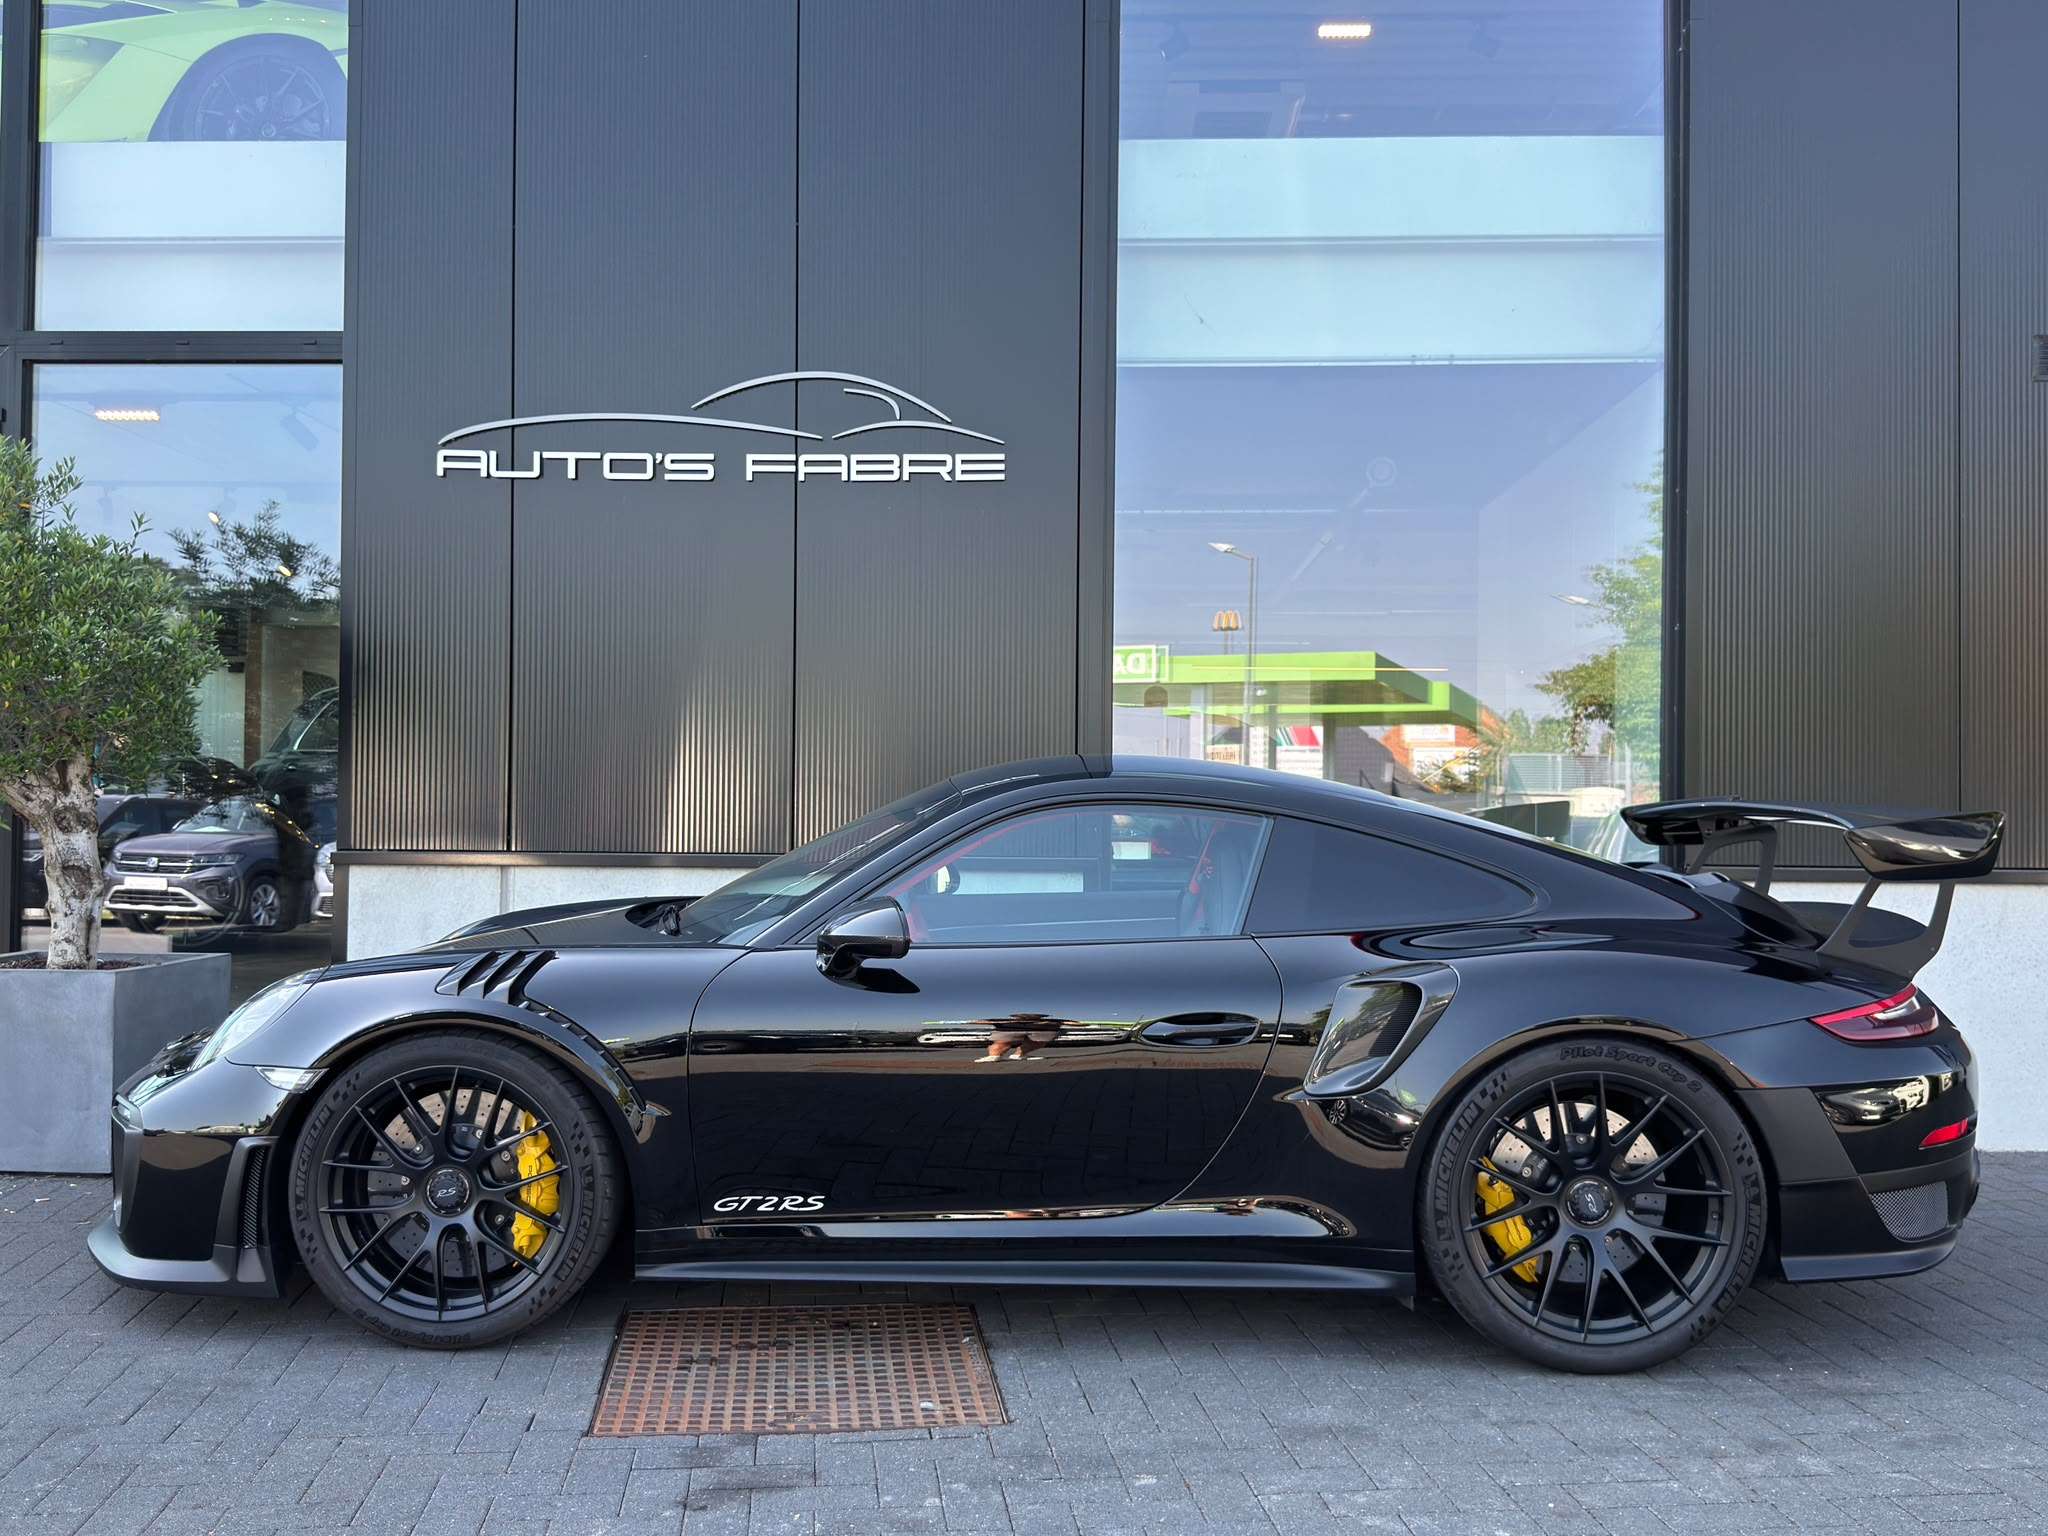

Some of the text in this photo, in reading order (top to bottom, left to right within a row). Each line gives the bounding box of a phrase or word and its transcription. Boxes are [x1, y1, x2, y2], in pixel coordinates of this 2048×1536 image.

[437, 450, 1005, 481] AUTO'S FABRE
[1559, 1047, 1604, 1060] Pilot
[1604, 1048, 1657, 1067] Sport
[295, 1105, 333, 1197] MICHELIN
[1434, 1101, 1480, 1213] MICHELIN
[555, 1189, 594, 1280] MICHELIN
